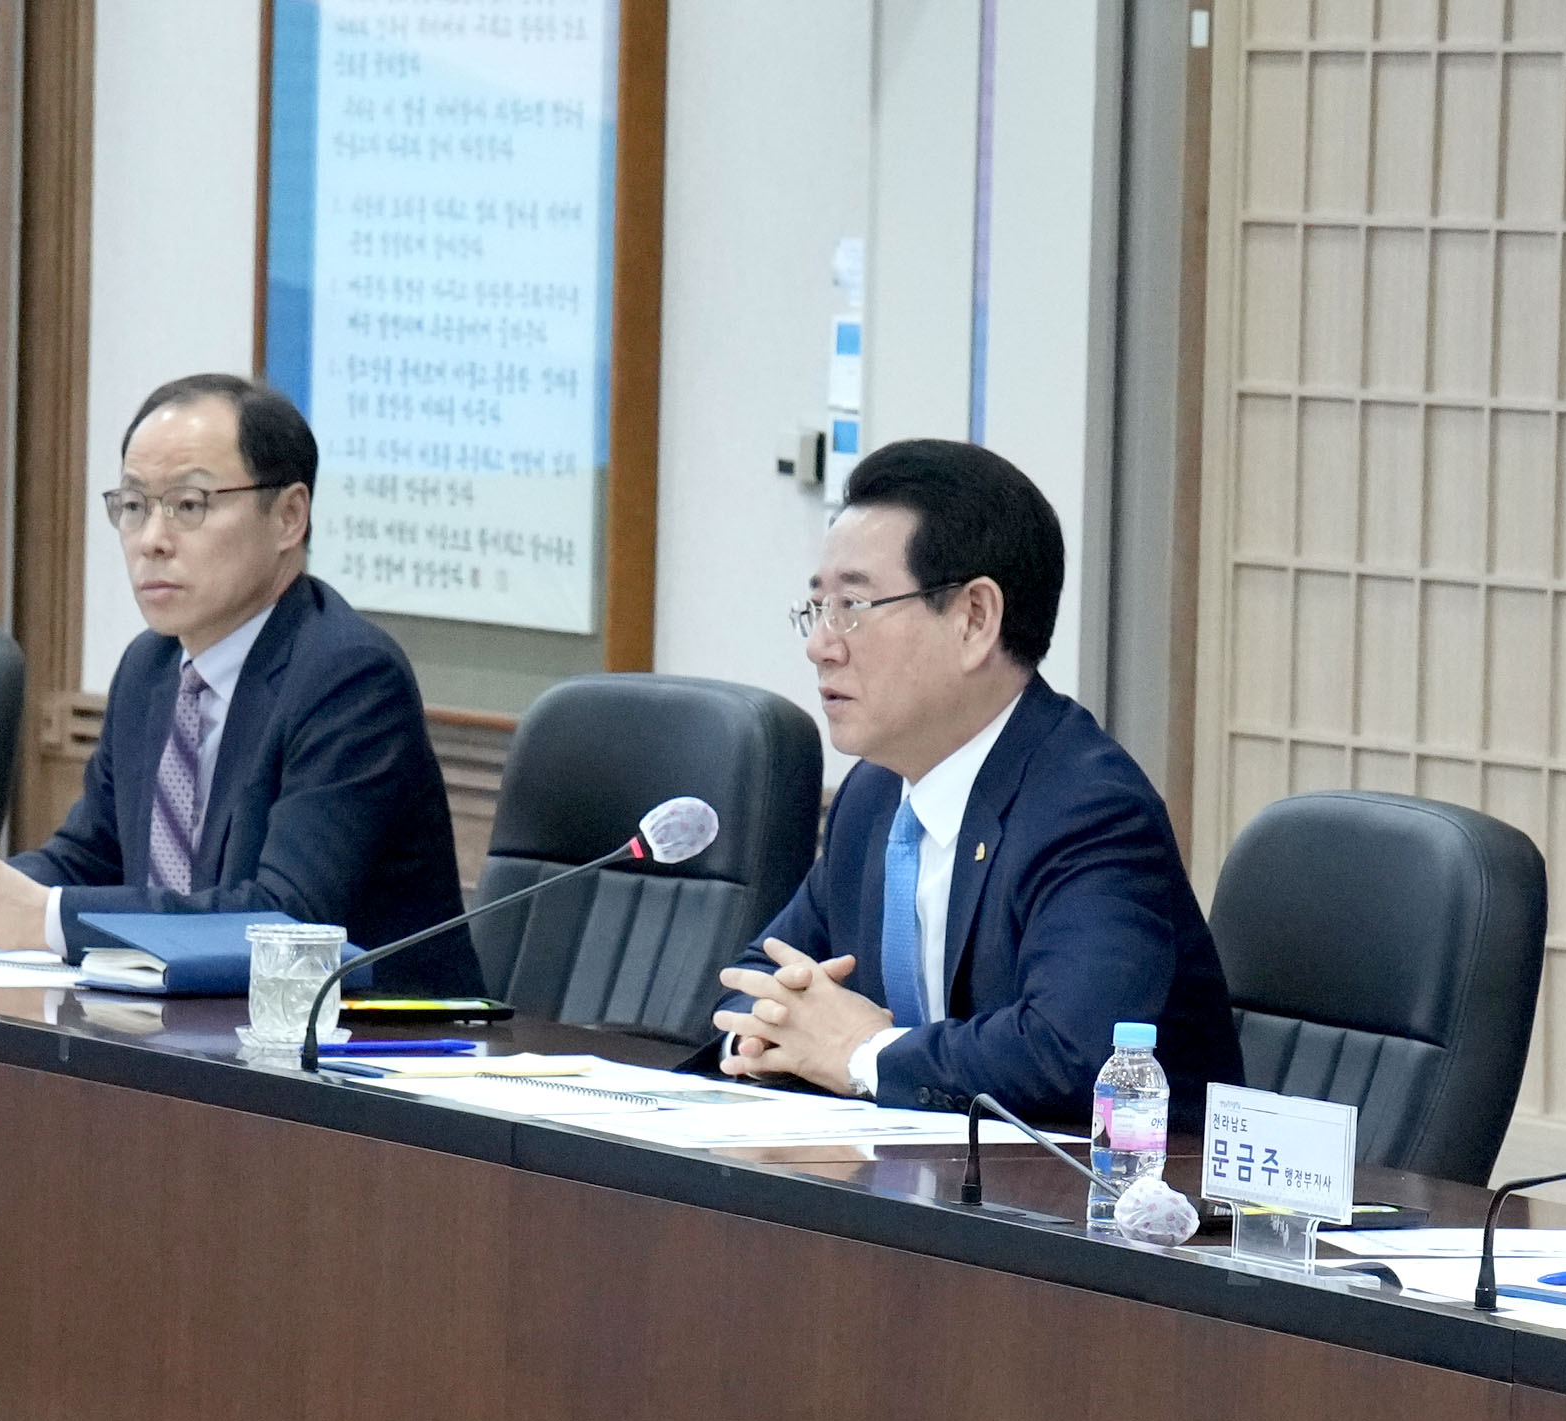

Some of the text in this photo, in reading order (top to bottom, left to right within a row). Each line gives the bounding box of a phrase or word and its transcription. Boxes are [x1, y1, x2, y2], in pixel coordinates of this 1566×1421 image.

[1212, 1113, 1248, 1133] 전라남도
[1211, 1139, 1332, 1193] 문금주 행정부지사
